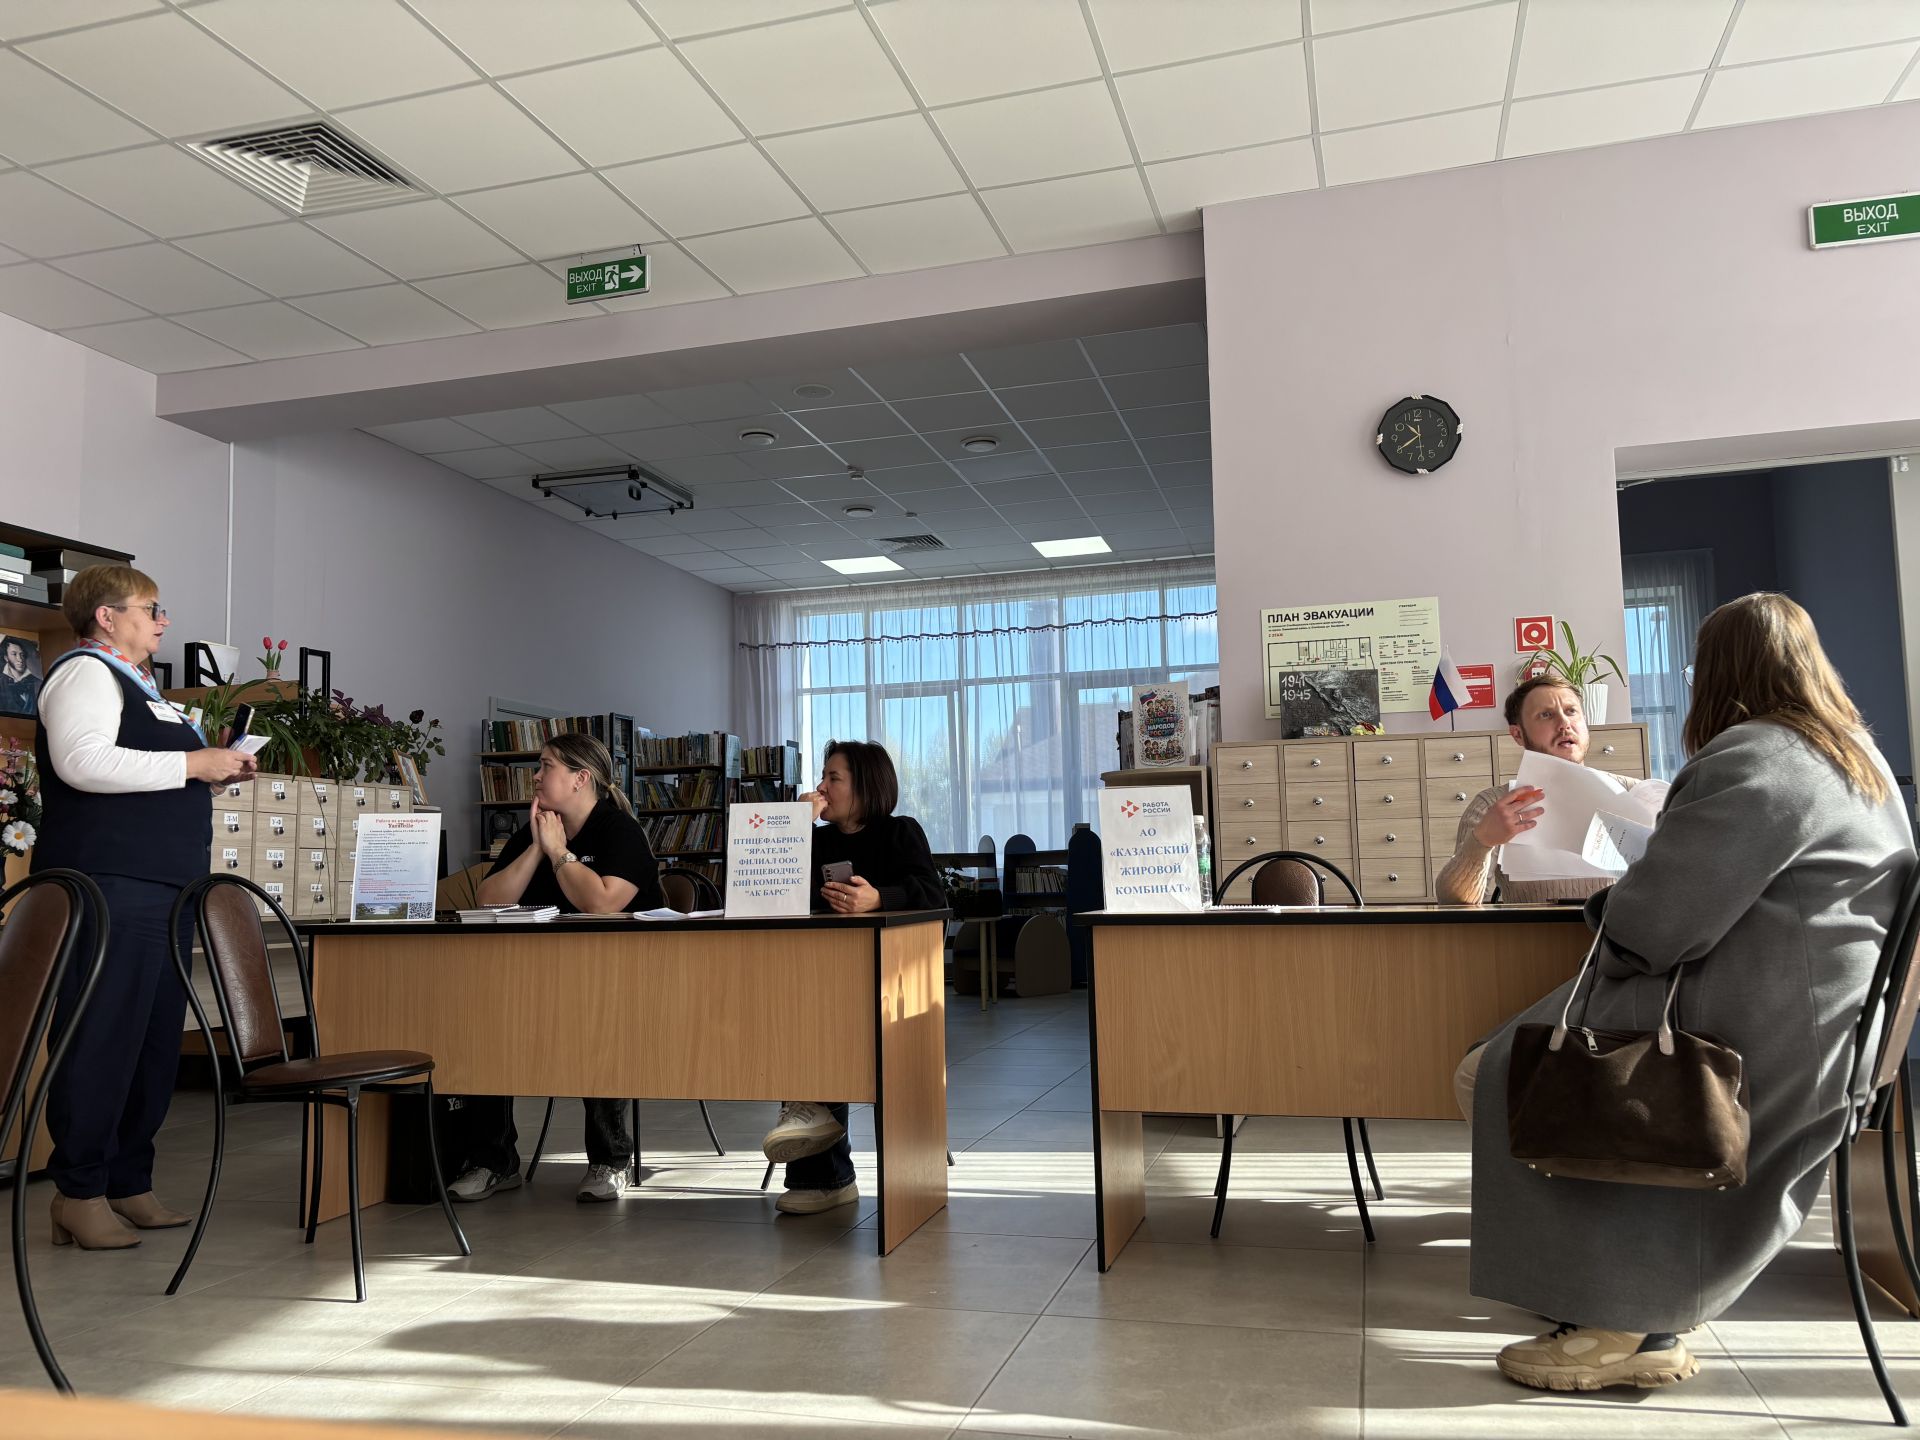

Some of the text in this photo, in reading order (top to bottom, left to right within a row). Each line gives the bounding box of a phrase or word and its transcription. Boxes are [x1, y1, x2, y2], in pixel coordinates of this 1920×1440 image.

[1843, 203, 1899, 222] ВЫХОД
[1857, 221, 1889, 235] EXIT
[569, 268, 602, 284] ВЫХОД
[576, 282, 597, 293] EXIT
[1404, 413, 1411, 421] 11
[1413, 409, 1422, 418] 12
[1395, 422, 1405, 431] 10
[1436, 418, 1444, 427] 2
[1440, 428, 1448, 437] 3
[1391, 434, 1398, 442] 9
[1407, 453, 1413, 461] 7
[1428, 450, 1436, 458] 5
[1267, 607, 1374, 623] ПЛАН ЭВАКУАЦИИ
[1281, 674, 1305, 688] 1941
[1282, 689, 1312, 701] 1945
[1139, 827, 1157, 837] АО
[733, 836, 805, 845] ПТИЦЕФАБРИКА
[744, 847, 793, 855] "ЯРАТЕЛЬ"
[1110, 843, 1190, 857] «КАЗАНСКИЙ
[738, 857, 776, 865] ФИЛИАЛ
[1120, 862, 1182, 876] ЖИРОВОЙ
[732, 878, 804, 887] КИЙ КОМПЛЕКС
[763, 888, 790, 896] БАРС"
[1115, 883, 1191, 895] КОМБИНАТ»
